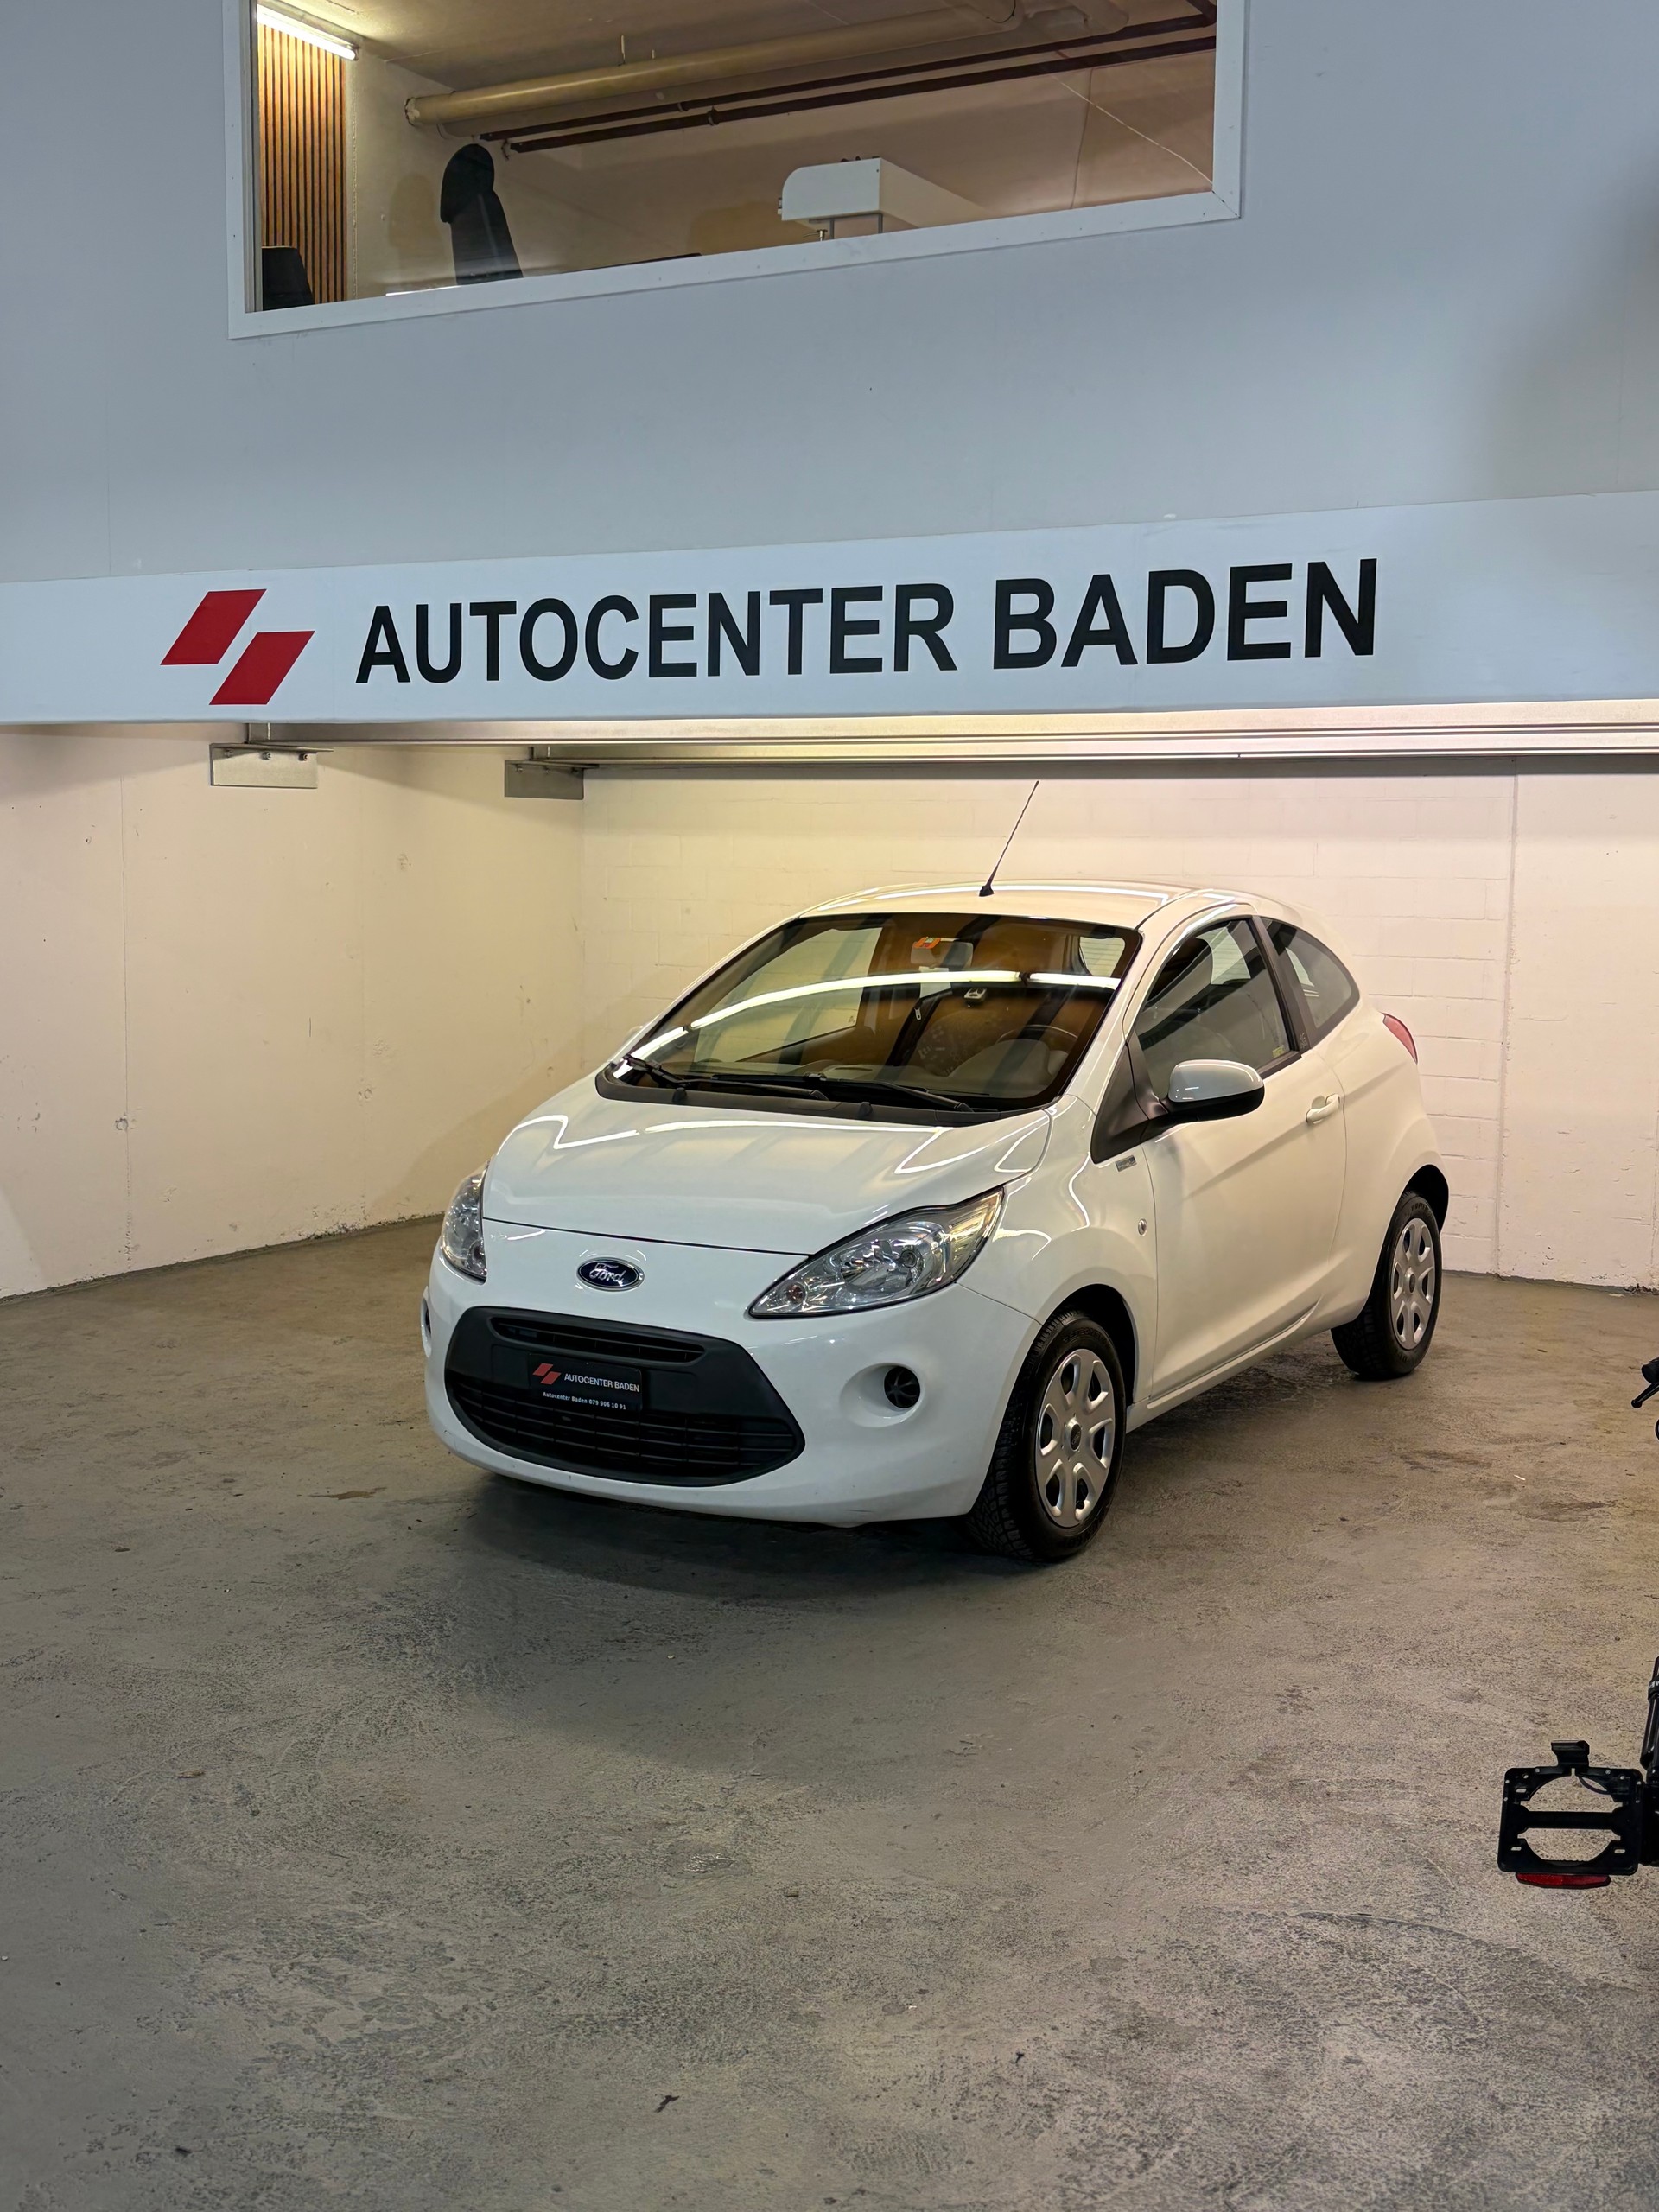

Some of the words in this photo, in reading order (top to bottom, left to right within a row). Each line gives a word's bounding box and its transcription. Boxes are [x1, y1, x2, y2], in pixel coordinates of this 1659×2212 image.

[356, 583, 957, 683] AUTOCENTER
[994, 558, 1376, 669] BADEN
[589, 1262, 626, 1282] Ford
[564, 1373, 613, 1389] AUTOCENTER
[614, 1381, 639, 1392] BADEN
[543, 1391, 570, 1401] Autocenter
